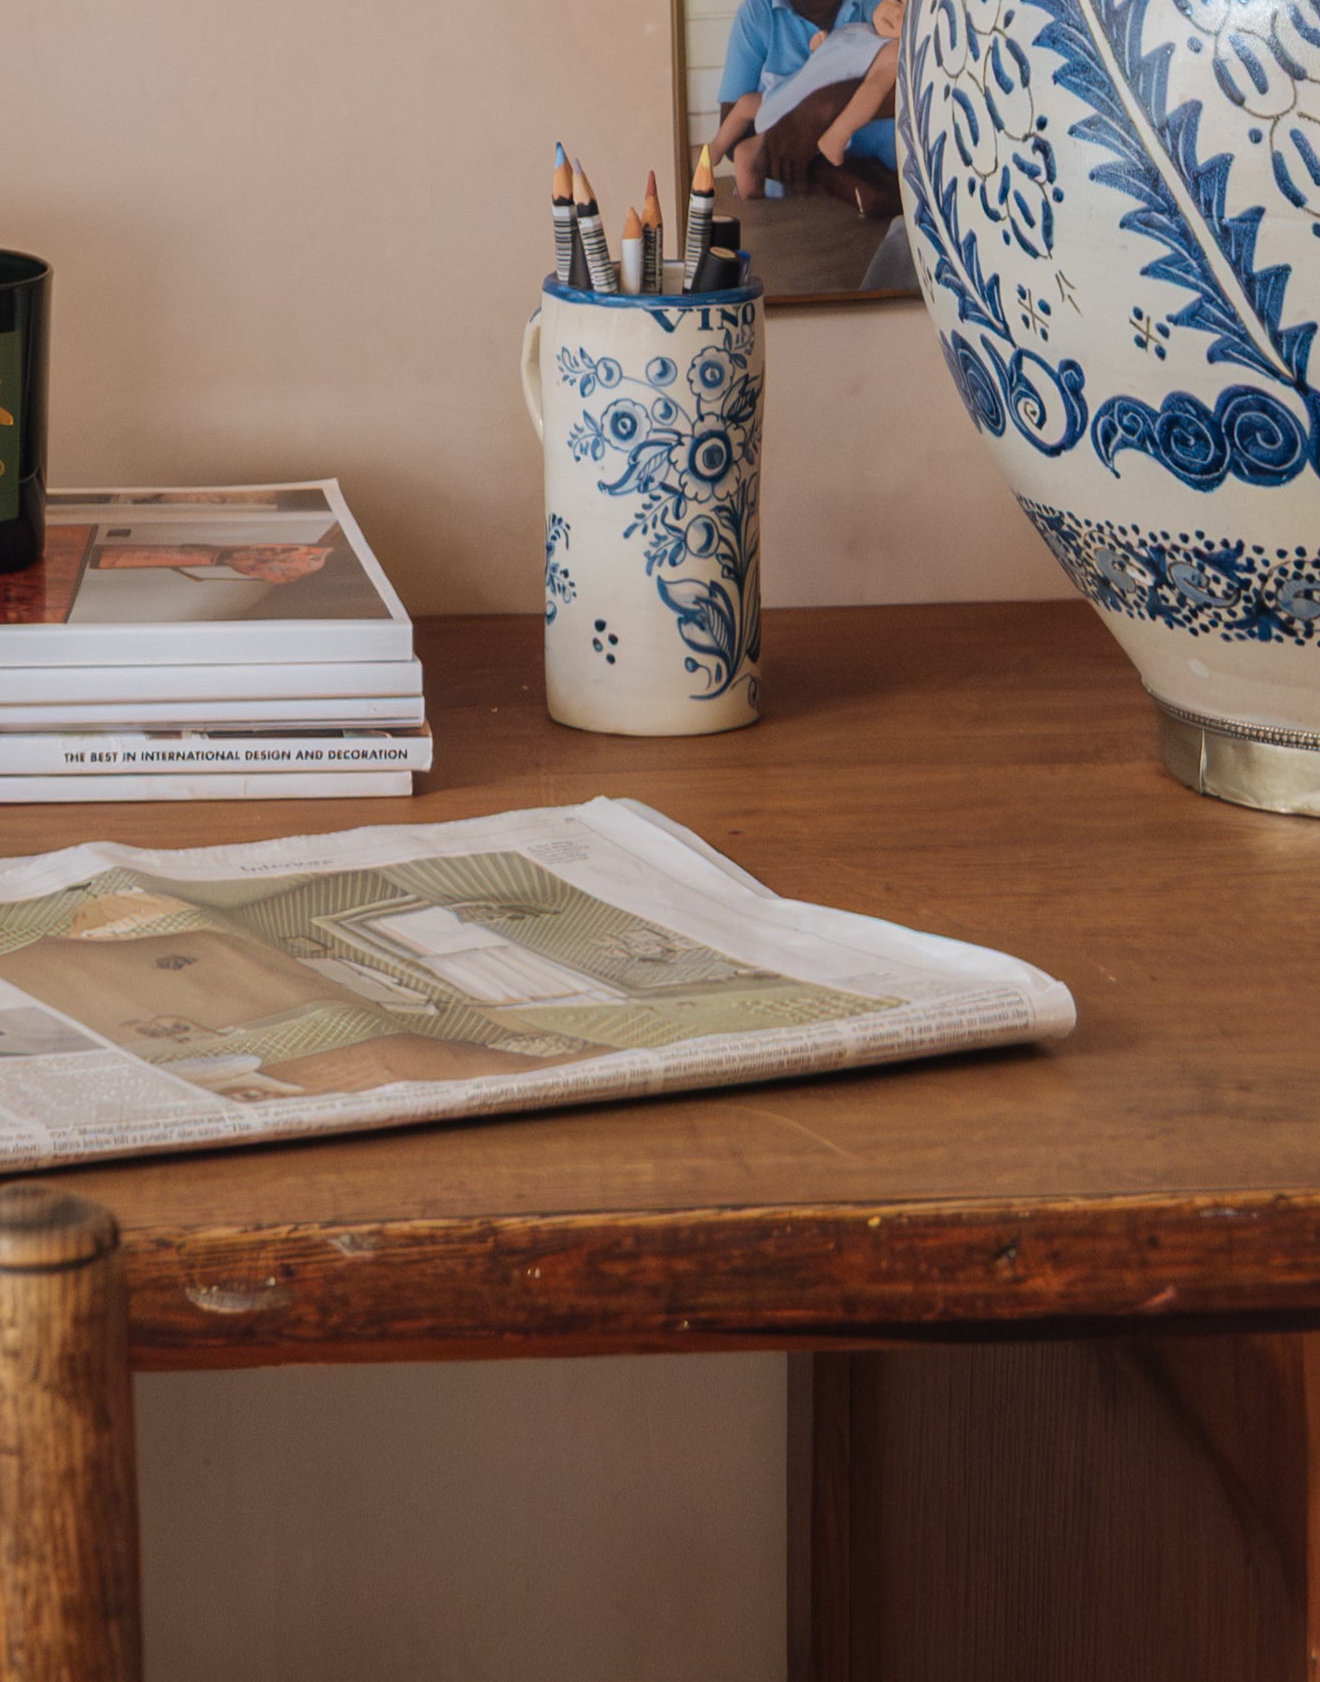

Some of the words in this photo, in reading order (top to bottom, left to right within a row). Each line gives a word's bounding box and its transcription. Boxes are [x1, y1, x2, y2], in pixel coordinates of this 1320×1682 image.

[642, 302, 756, 334] VINO
[63, 752, 86, 763] THE
[89, 752, 118, 763] BEST
[121, 751, 137, 762] IN
[140, 750, 241, 762] INTERNATIONAL
[244, 750, 291, 761] DESIGN
[295, 749, 324, 761] AND
[327, 748, 408, 760] DECORATION
